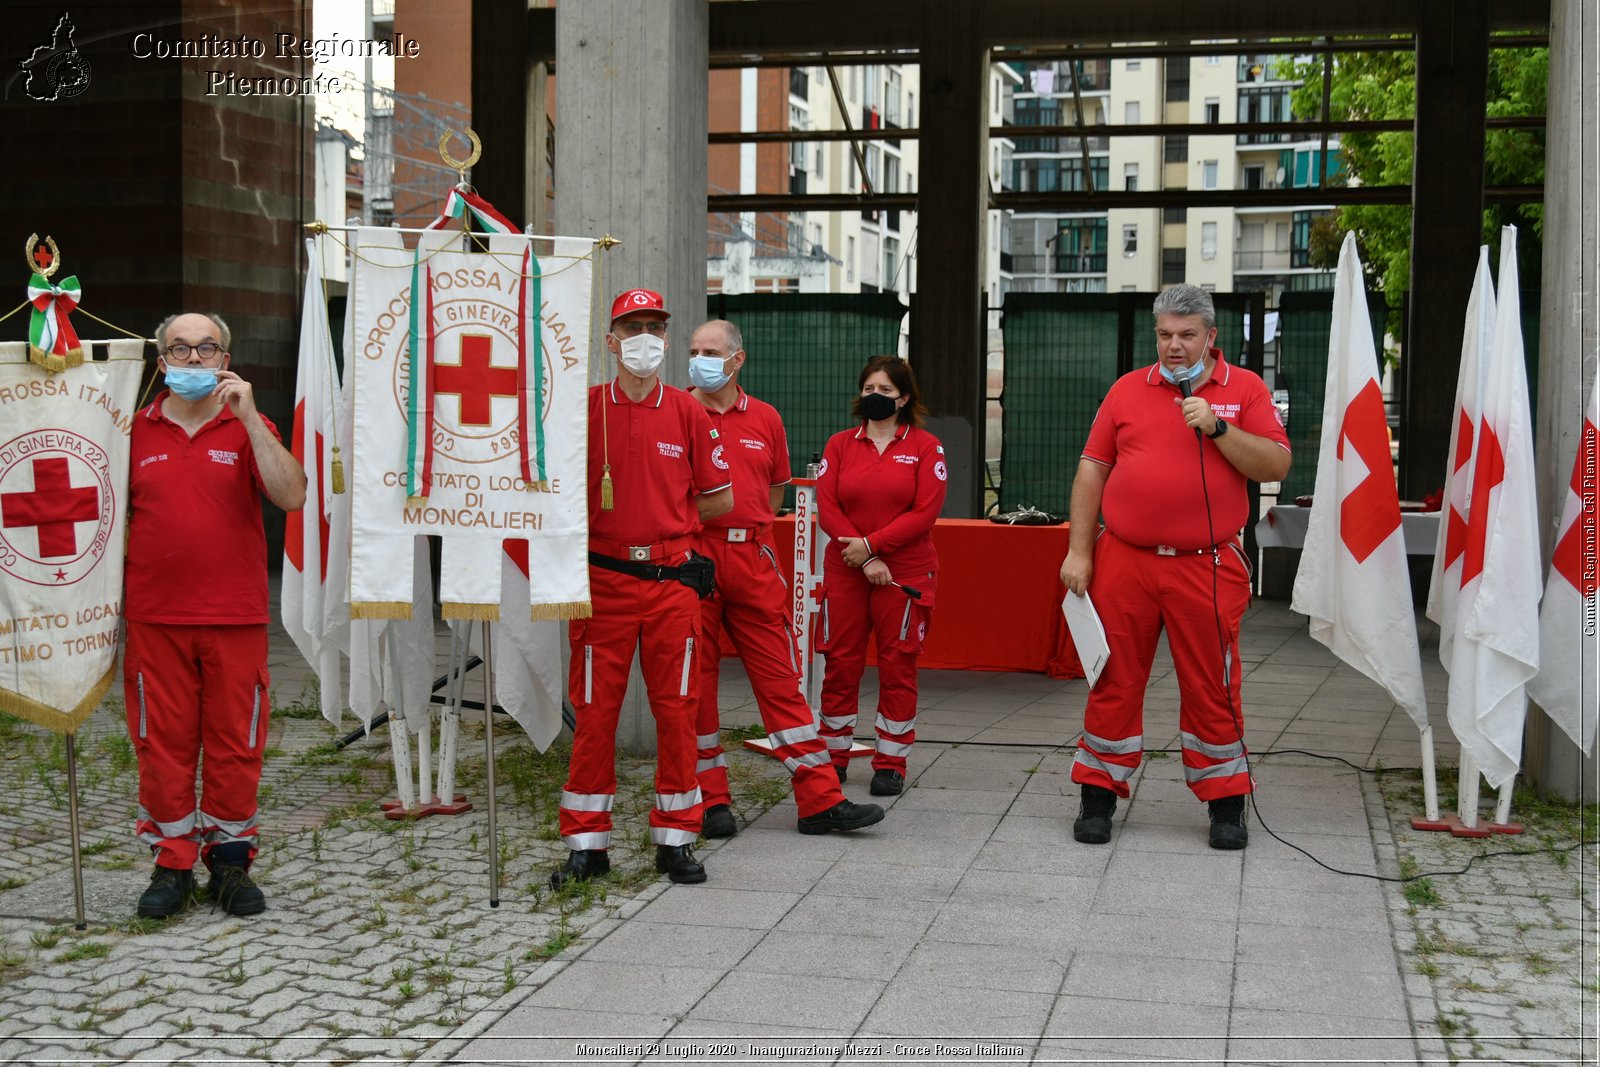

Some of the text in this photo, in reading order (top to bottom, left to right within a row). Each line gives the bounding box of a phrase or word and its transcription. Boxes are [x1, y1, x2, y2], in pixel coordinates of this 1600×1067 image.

[0, 379, 70, 406] ROSSA
[0, 447, 18, 465] DI
[17, 433, 82, 455] GINEVRA
[85, 446, 103, 466] 22
[465, 492, 484, 508] DI
[402, 507, 543, 530] MONCALIERI
[796, 491, 807, 562] CROCE
[76, 601, 121, 627] LOCAL
[795, 571, 804, 639] ROSSA
